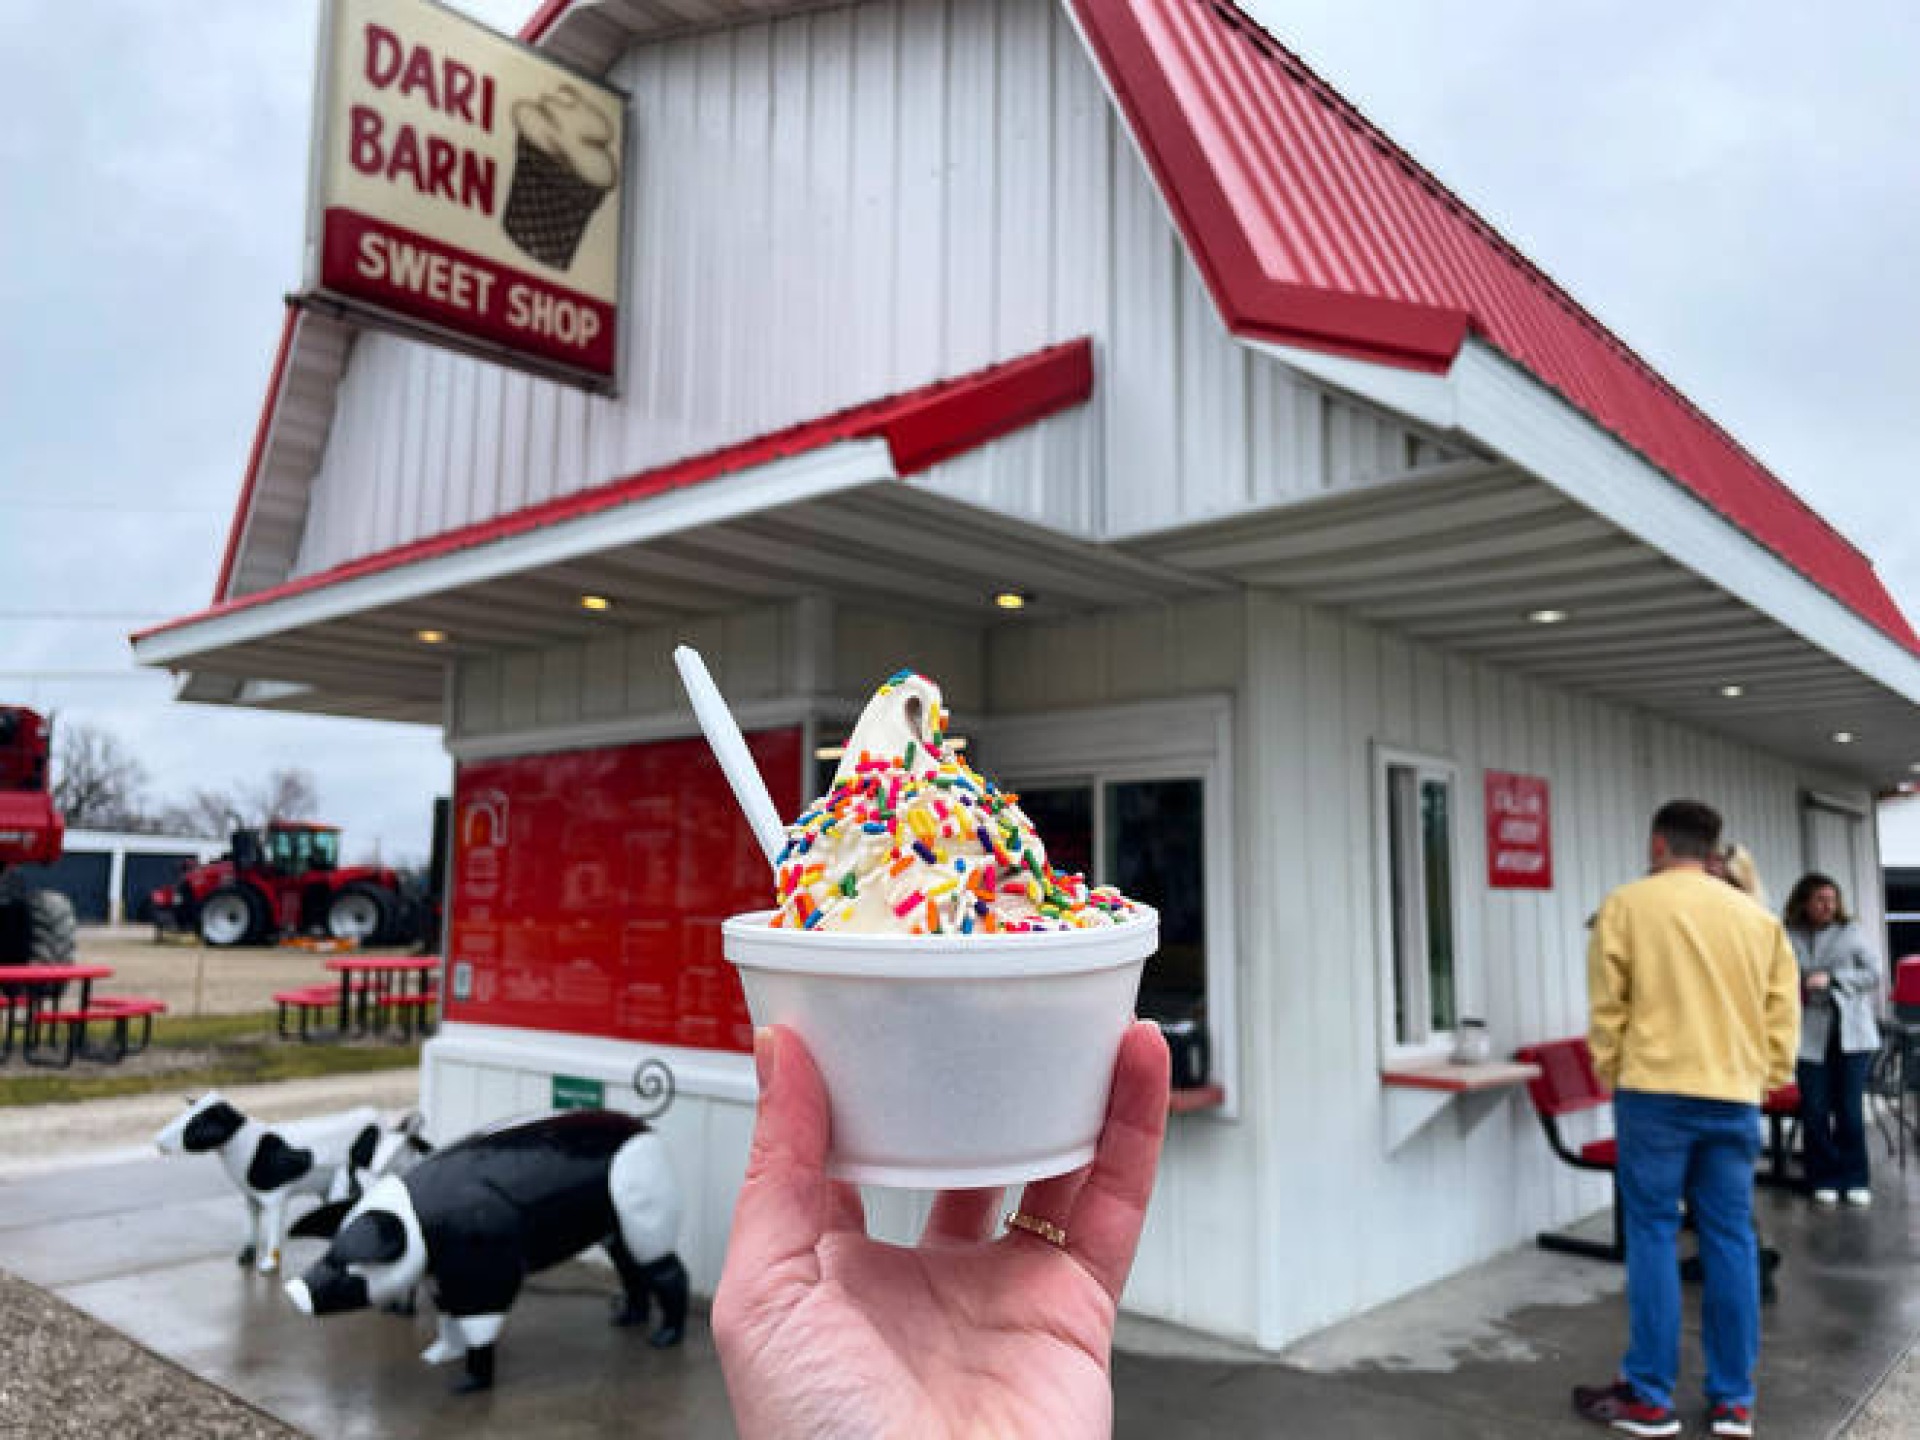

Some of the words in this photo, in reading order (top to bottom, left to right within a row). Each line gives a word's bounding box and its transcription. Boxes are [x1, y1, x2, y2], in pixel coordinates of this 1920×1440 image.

[364, 23, 496, 133] DARI
[349, 105, 496, 217] BARN
[357, 232, 496, 314] SWEET
[506, 284, 600, 347] SHOP
